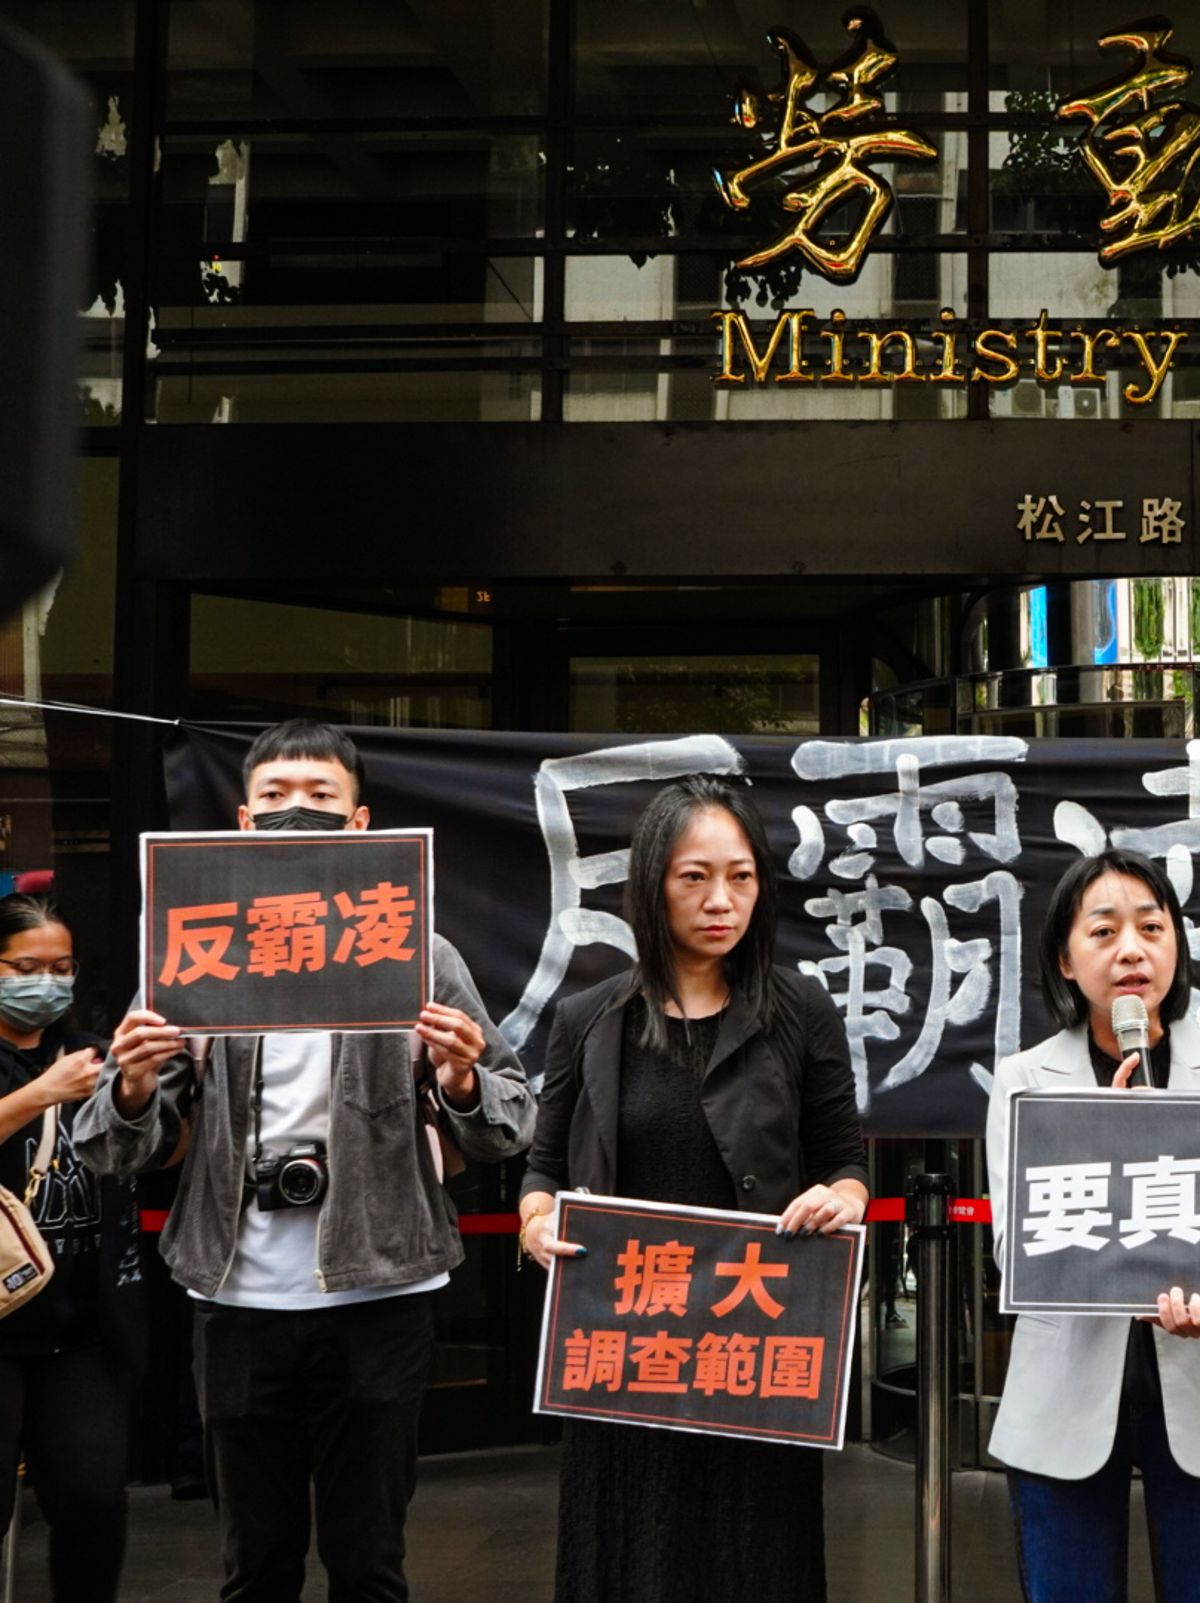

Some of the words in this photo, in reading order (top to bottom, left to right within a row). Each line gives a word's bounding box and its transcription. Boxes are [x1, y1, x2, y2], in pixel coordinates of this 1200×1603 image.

[711, 308, 1189, 403] Ministry
[158, 881, 416, 987] 反霸凌
[614, 1239, 789, 1320] 擴大
[562, 1329, 825, 1400] 調查範圍
